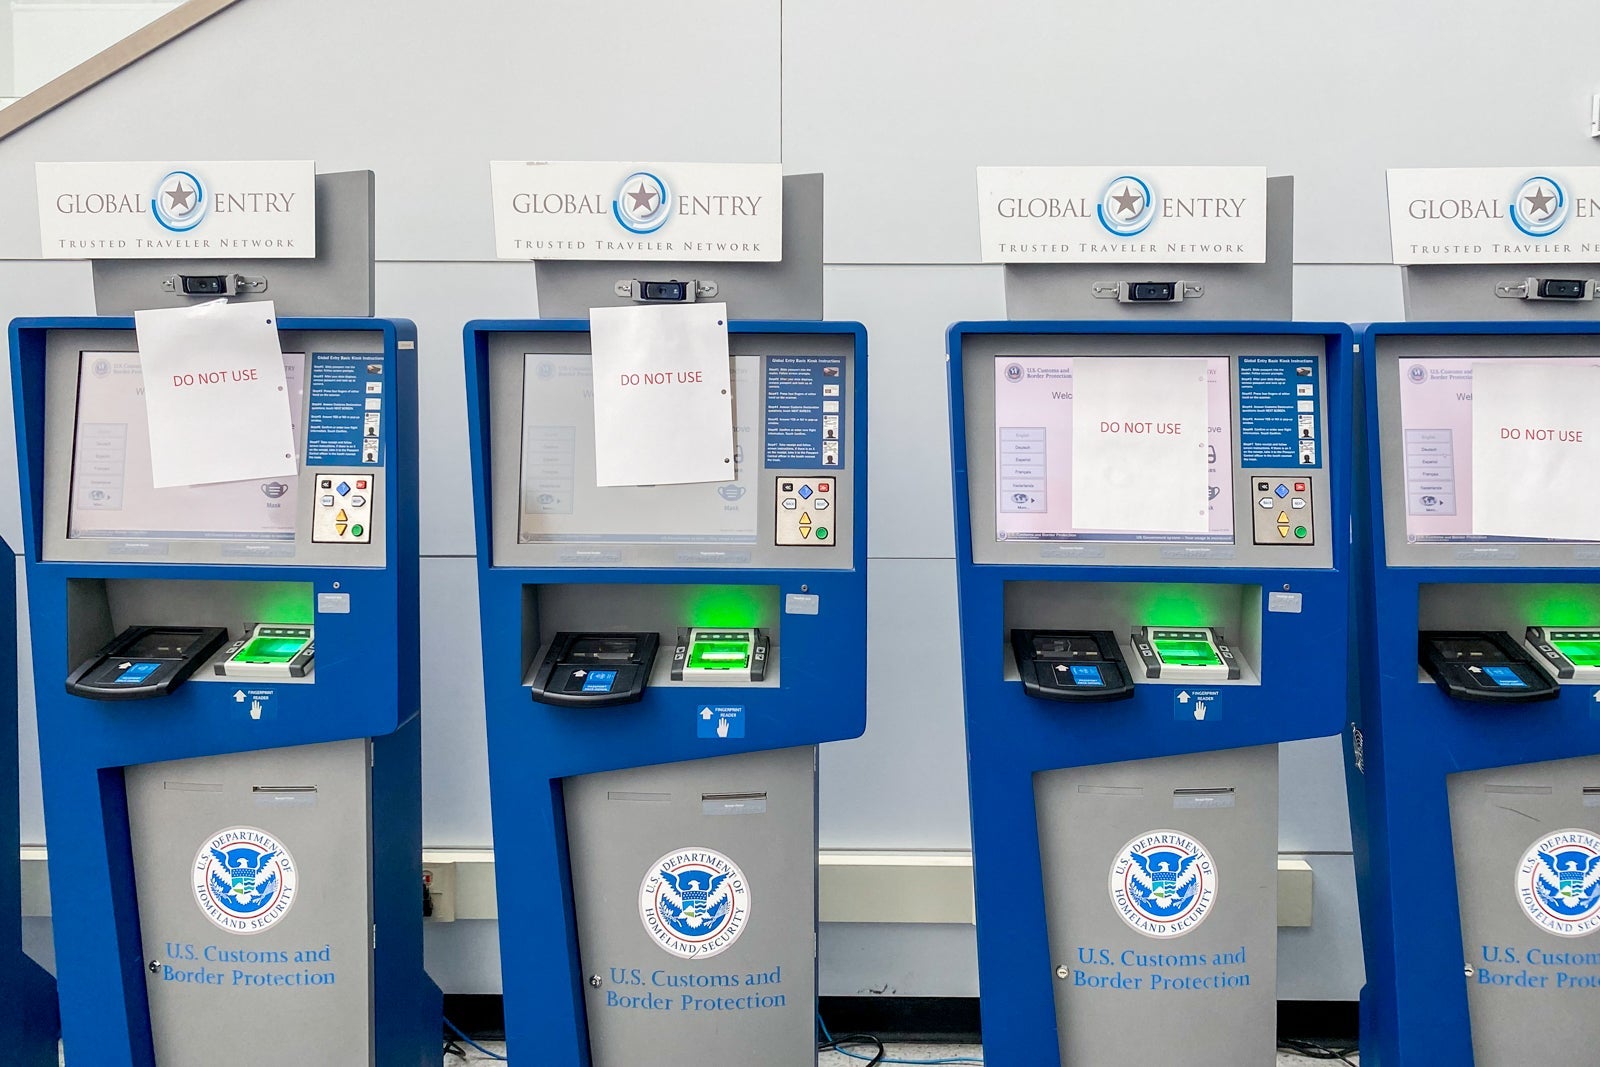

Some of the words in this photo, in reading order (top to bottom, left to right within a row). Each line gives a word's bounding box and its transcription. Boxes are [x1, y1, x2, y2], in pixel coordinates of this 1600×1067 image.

[56, 193, 147, 214] GLOBAL
[214, 192, 295, 213] ENTRY
[512, 193, 608, 215] GLOBAL
[678, 195, 763, 216] ENTRY
[997, 197, 1092, 218] GLOBAL
[1162, 198, 1247, 218] ENTRY
[1408, 199, 1505, 220] GLOBAL
[173, 374, 194, 387] DO
[198, 371, 228, 385] NOT
[231, 368, 259, 382] USE
[620, 373, 640, 386] DO
[644, 372, 674, 385] NOT
[677, 370, 703, 384] USE
[1100, 421, 1120, 434] DO
[1124, 422, 1153, 434] NOT
[1156, 422, 1182, 435] USE
[1500, 427, 1521, 440] DO
[1525, 428, 1555, 441] NOT
[1558, 430, 1583, 443] USE
[197, 853, 211, 871] U.S.
[211, 831, 285, 858] DEPARTMENT
[281, 858, 293, 873] OF
[1116, 857, 1130, 875] U.S.
[1132, 834, 1206, 860] DEPARTMENT
[1201, 861, 1213, 876] OF
[646, 876, 661, 894] U.S.
[662, 852, 737, 880] DEPARTMENT
[732, 879, 745, 895] OF
[1522, 856, 1538, 874] U.S.
[196, 884, 247, 930] HOMELAND
[251, 885, 293, 929] SECURITY
[1115, 889, 1166, 933] HOMELAND
[1170, 888, 1212, 933] SECURITY
[1521, 888, 1573, 932] HOMELAND
[645, 907, 697, 953] HOMELAND
[701, 907, 745, 953] SECURITY
[165, 943, 198, 961] U.S.
[203, 946, 288, 963] Customs
[294, 944, 331, 962] and
[1078, 947, 1114, 966] U.S.
[1121, 950, 1207, 967] Customs
[1212, 947, 1246, 965] and
[1481, 946, 1520, 963] U.S.
[163, 965, 225, 985] Border
[232, 970, 335, 986] Protection
[610, 967, 646, 986] U.S.
[651, 970, 739, 988] Customs
[745, 965, 782, 986] and
[1073, 970, 1142, 990] Border
[1150, 971, 1251, 990] Protection
[1478, 968, 1548, 988] Border
[606, 990, 672, 1011] Border
[680, 993, 786, 1011] Protection
